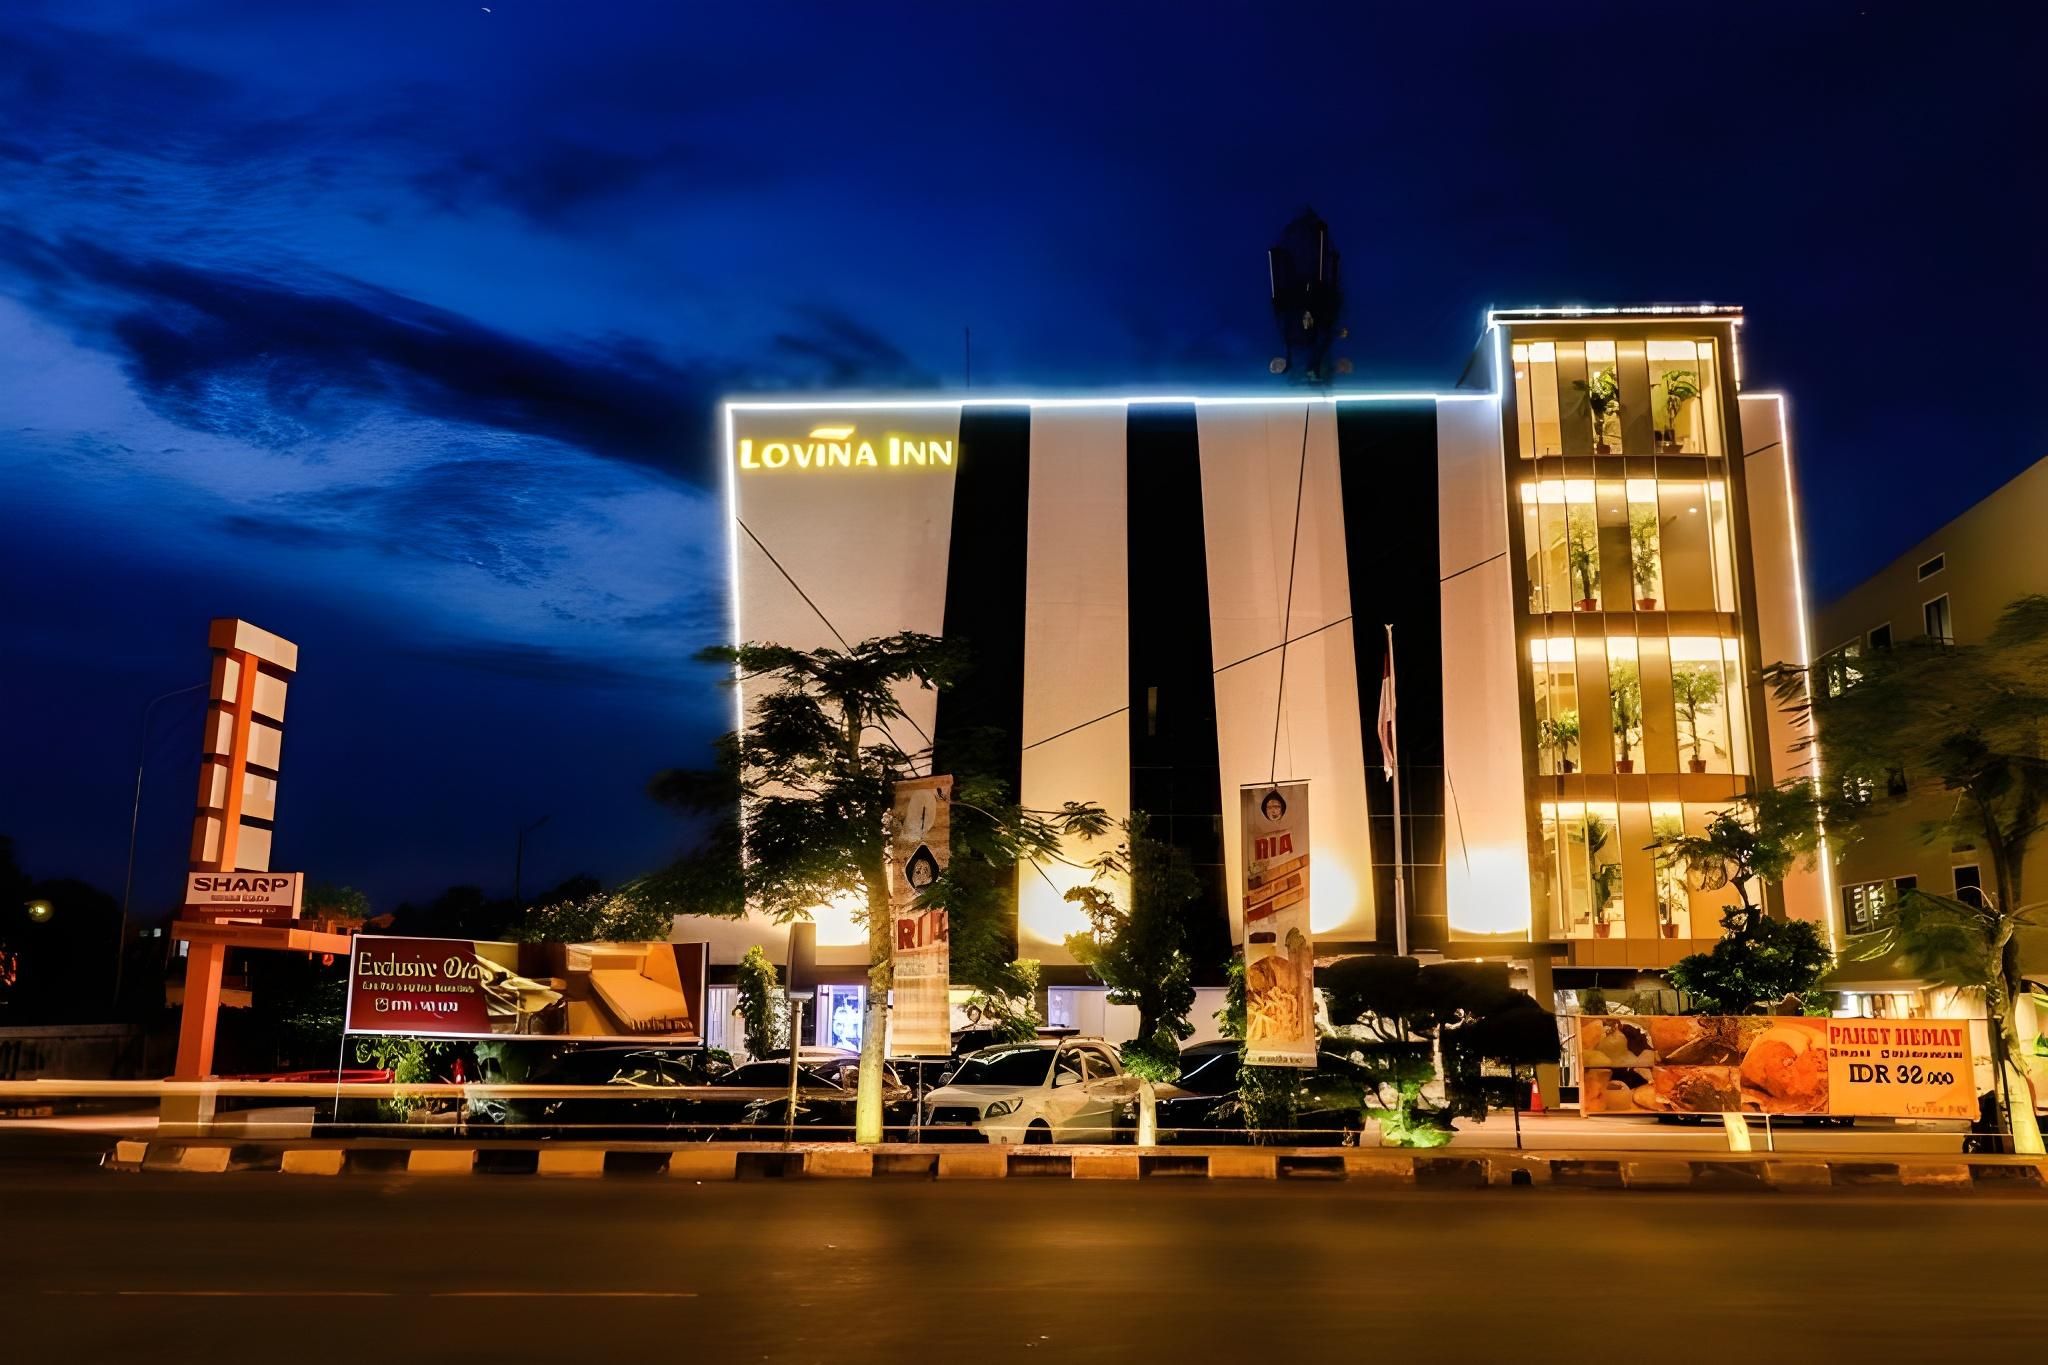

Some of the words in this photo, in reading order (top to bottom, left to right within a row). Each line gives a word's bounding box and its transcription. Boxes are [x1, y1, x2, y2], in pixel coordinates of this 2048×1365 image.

[888, 437, 953, 467] INN
[193, 877, 289, 893] SHARP
[1849, 1063, 1891, 1084] IDR
